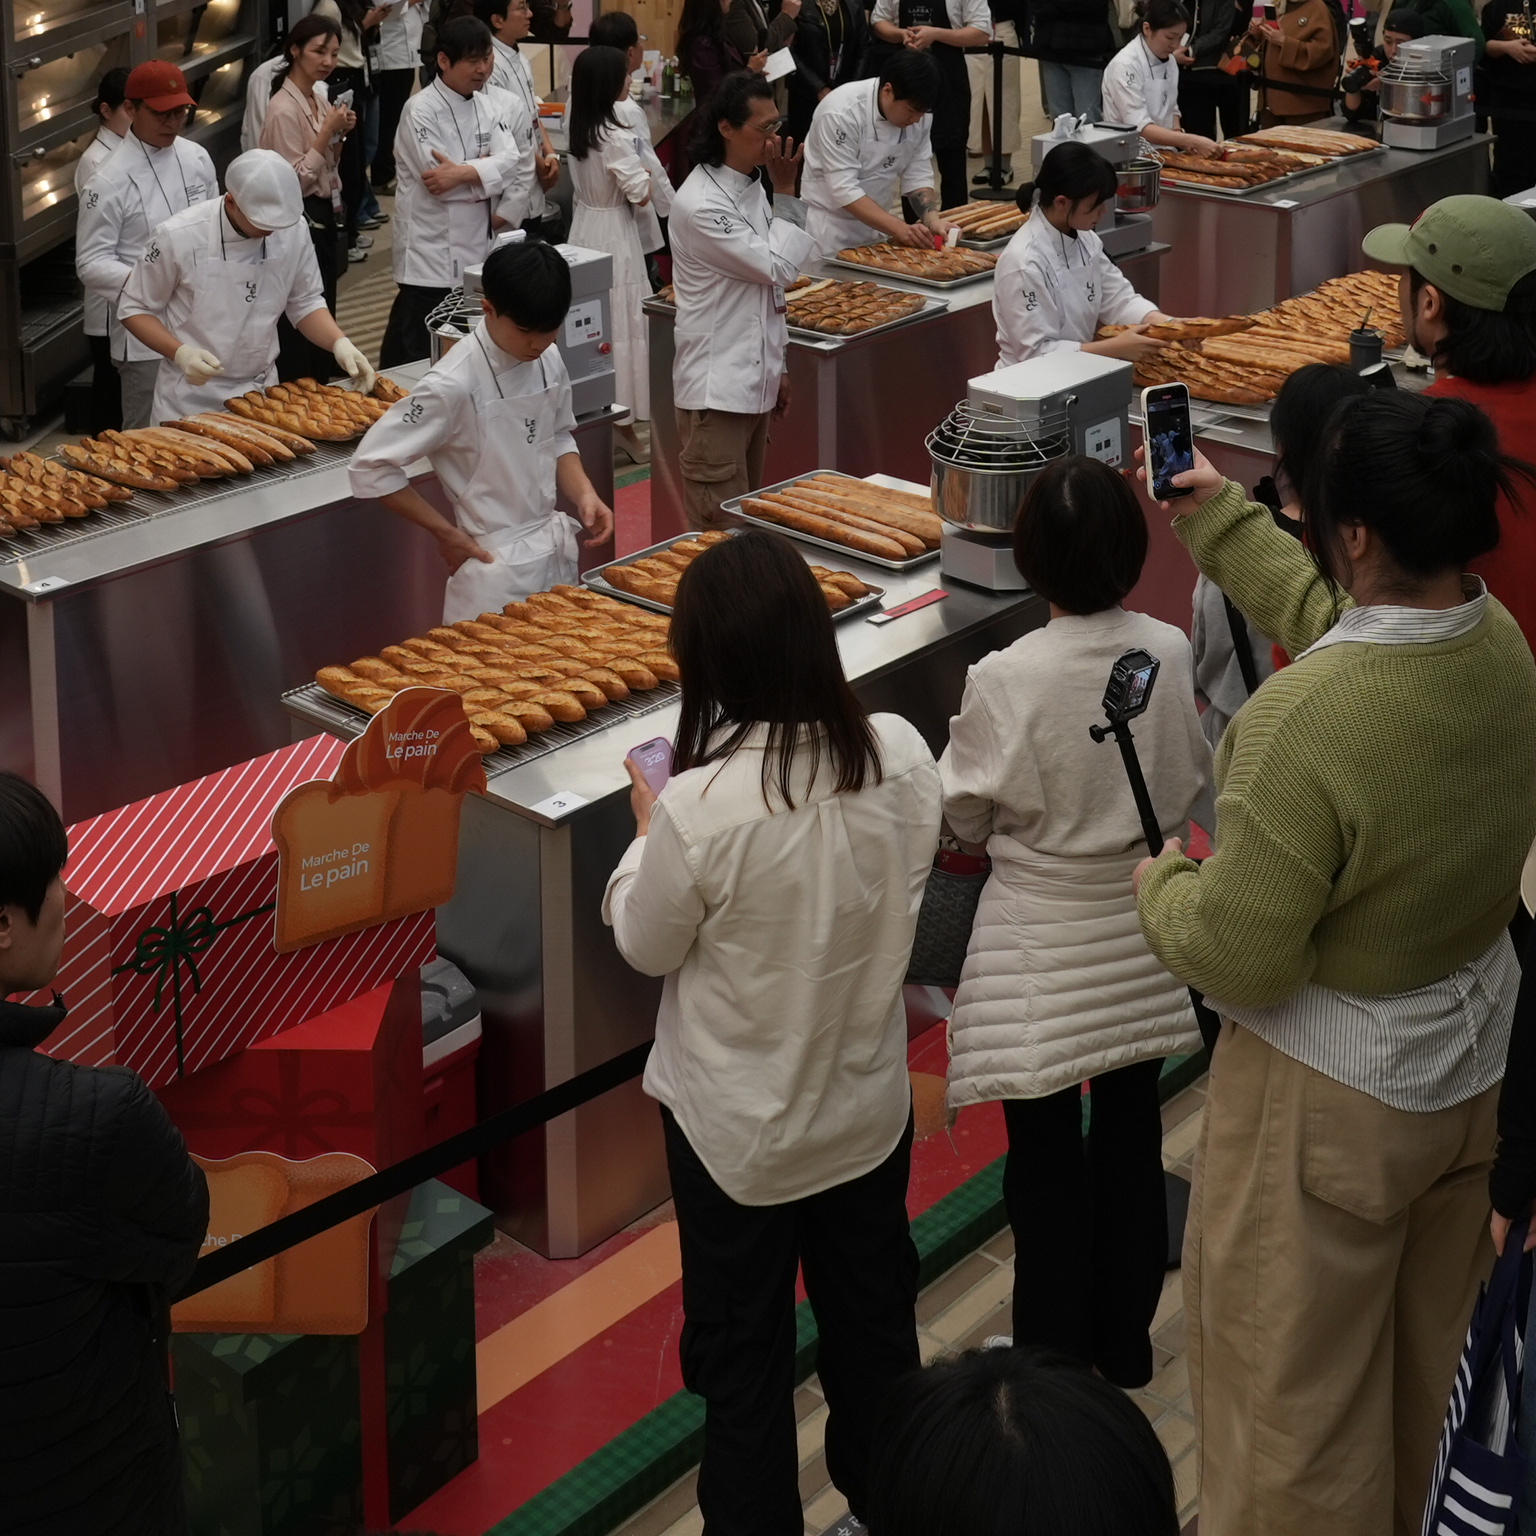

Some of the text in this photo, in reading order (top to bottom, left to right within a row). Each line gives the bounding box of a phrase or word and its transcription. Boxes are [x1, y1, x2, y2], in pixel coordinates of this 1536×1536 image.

[389, 729, 439, 742] Marche De
[301, 841, 370, 870] Marche De
